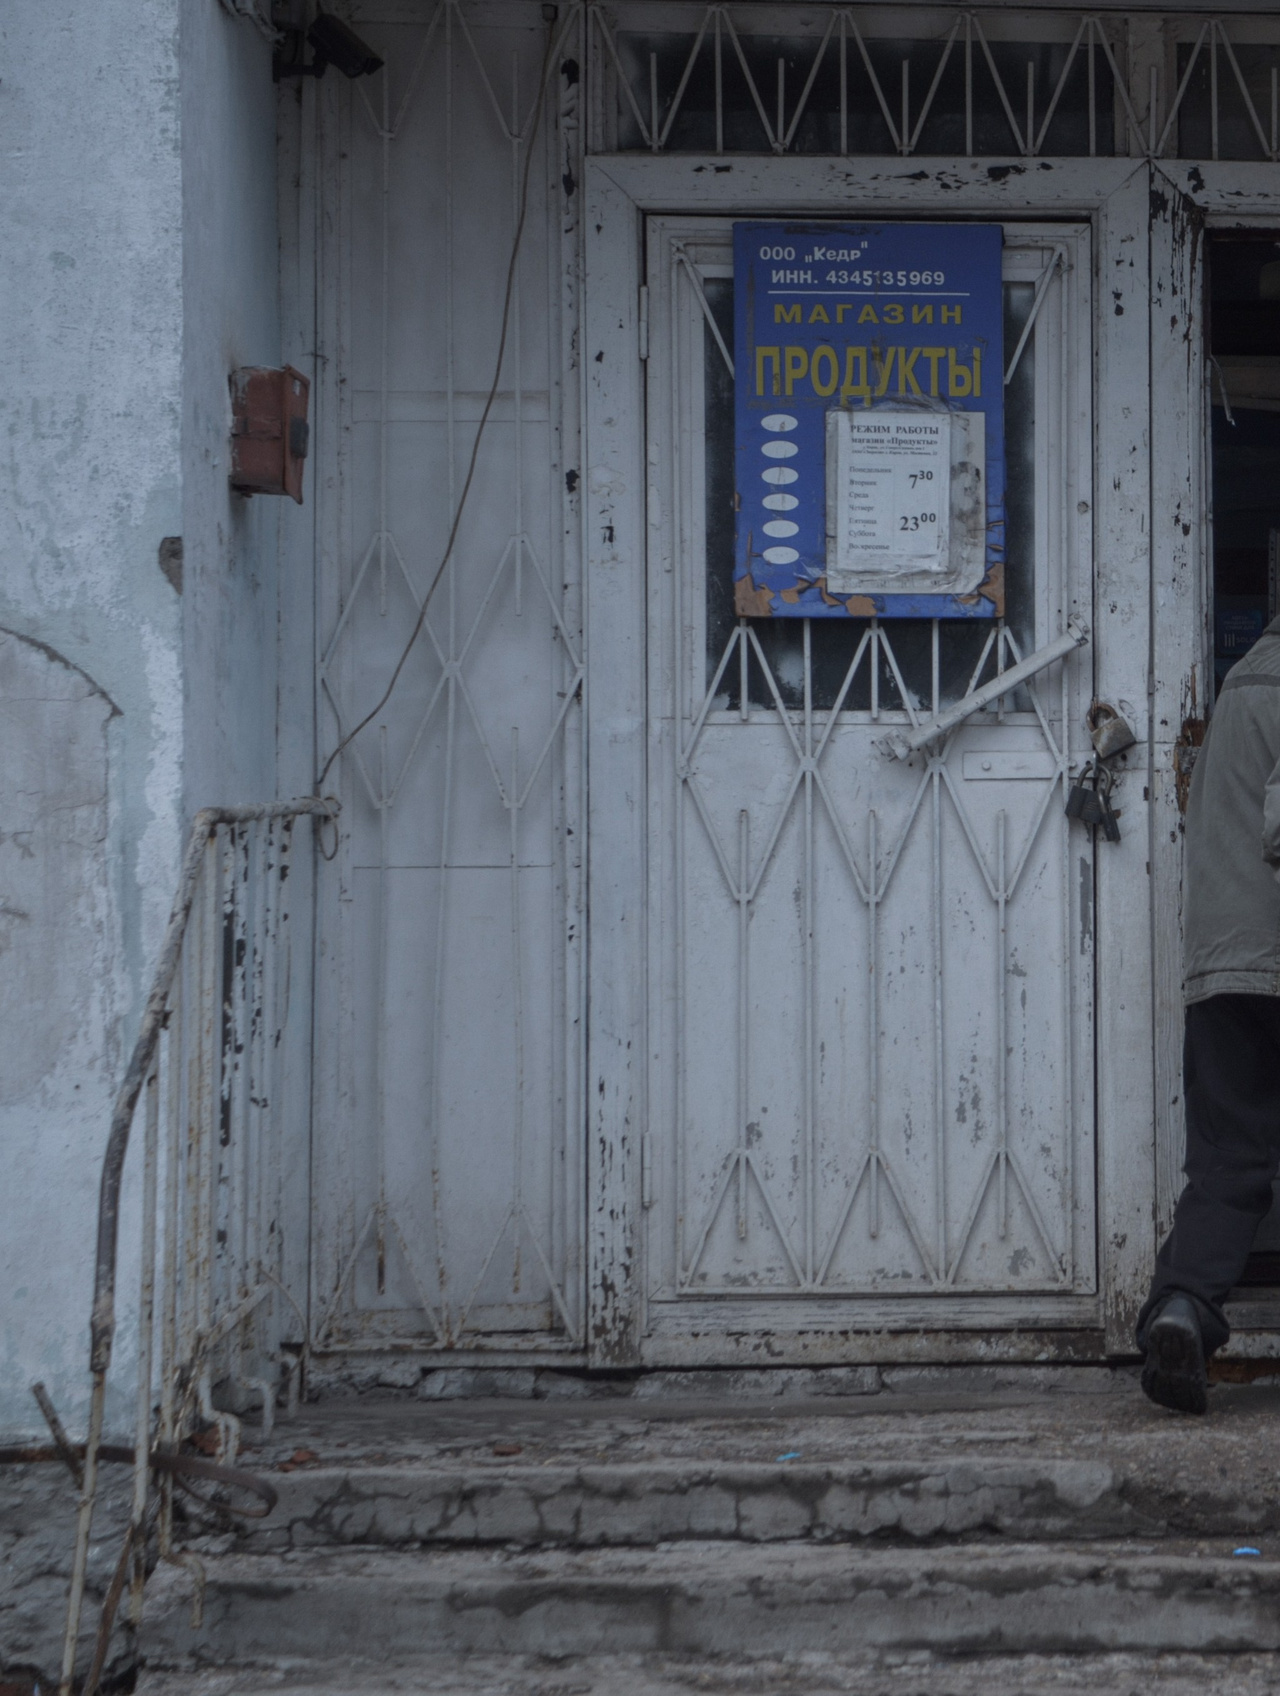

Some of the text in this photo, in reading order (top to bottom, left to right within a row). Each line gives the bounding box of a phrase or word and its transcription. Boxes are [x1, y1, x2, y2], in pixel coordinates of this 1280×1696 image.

[759, 246, 796, 261] ООО
[771, 270, 945, 286] ИНН. 4345135969
[773, 303, 962, 325] МАГАЗИН
[755, 344, 981, 407] ПРОДУКТЫ
[850, 425, 939, 435] РЕЖИМ РАБОТЫ
[848, 491, 869, 499] Среда
[848, 530, 876, 538] Суббота
